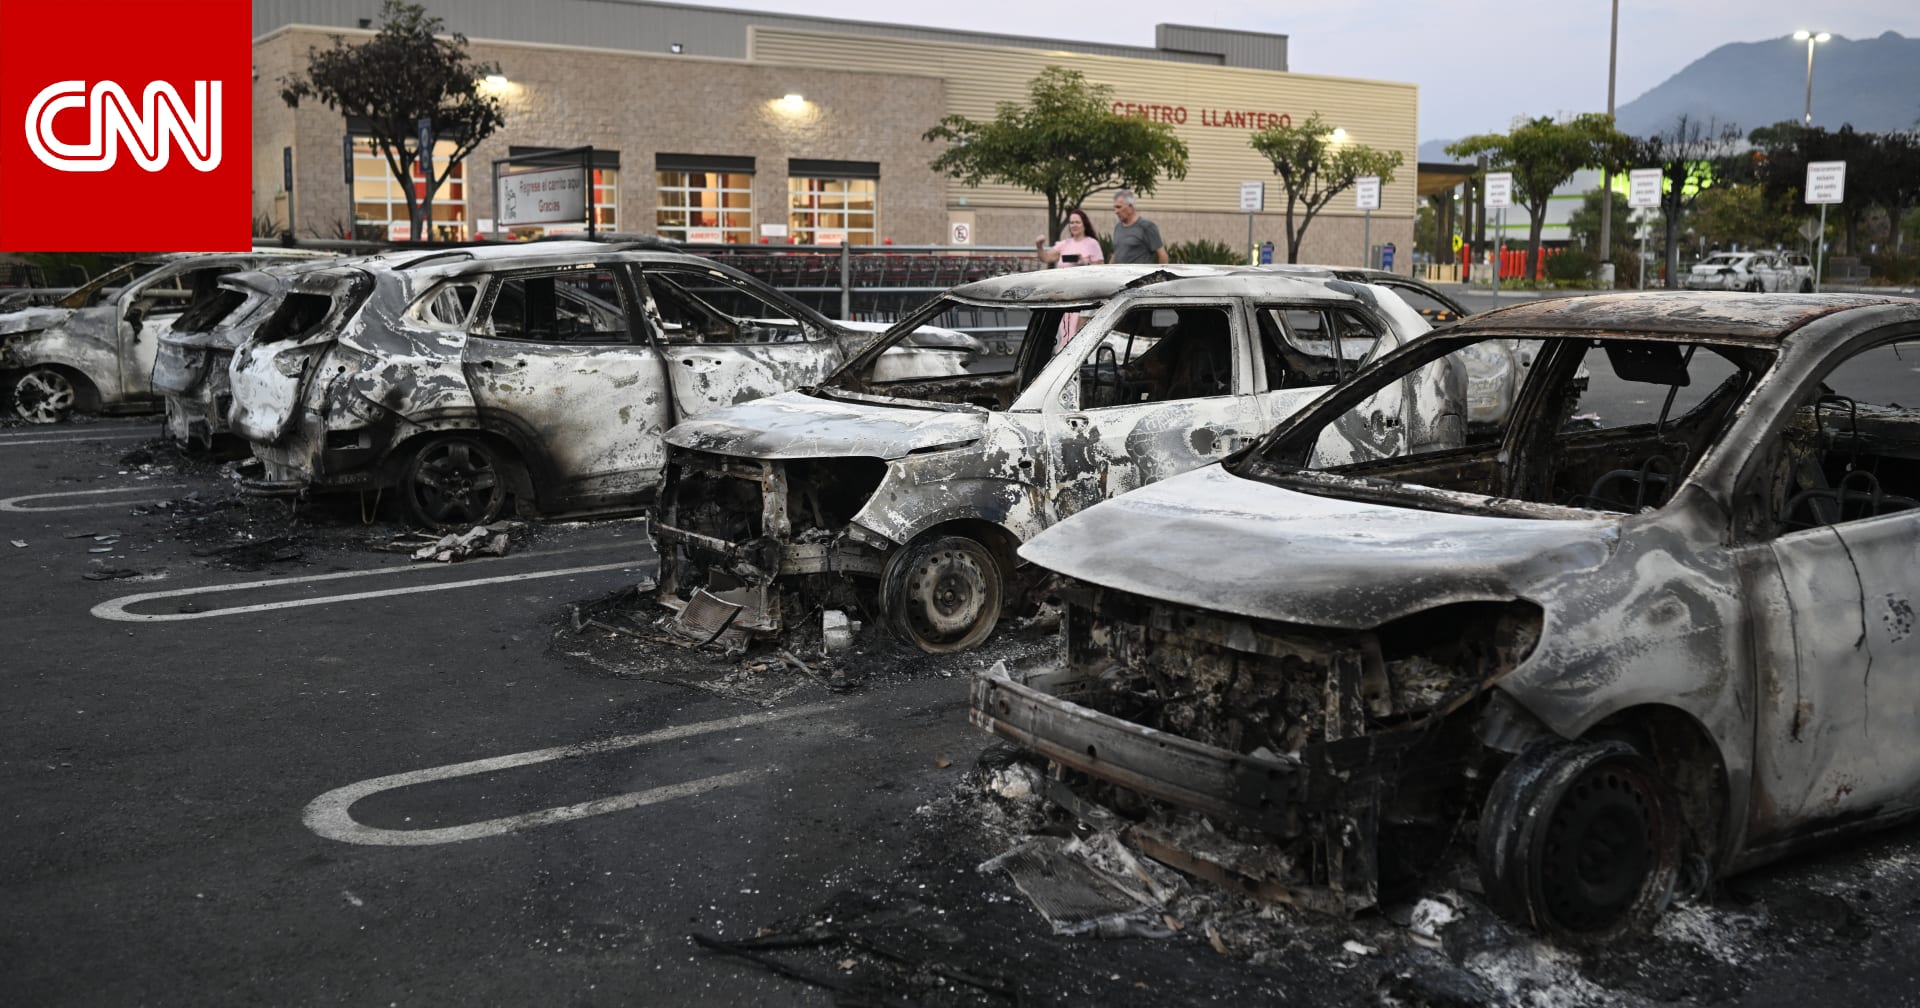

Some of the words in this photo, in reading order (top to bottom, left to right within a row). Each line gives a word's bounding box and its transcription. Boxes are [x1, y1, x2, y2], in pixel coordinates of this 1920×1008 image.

[1111, 101, 1188, 125] CENTRO
[1201, 107, 1292, 131] LLANTERO
[519, 180, 541, 196] Regrese
[538, 199, 561, 213] Gracias
